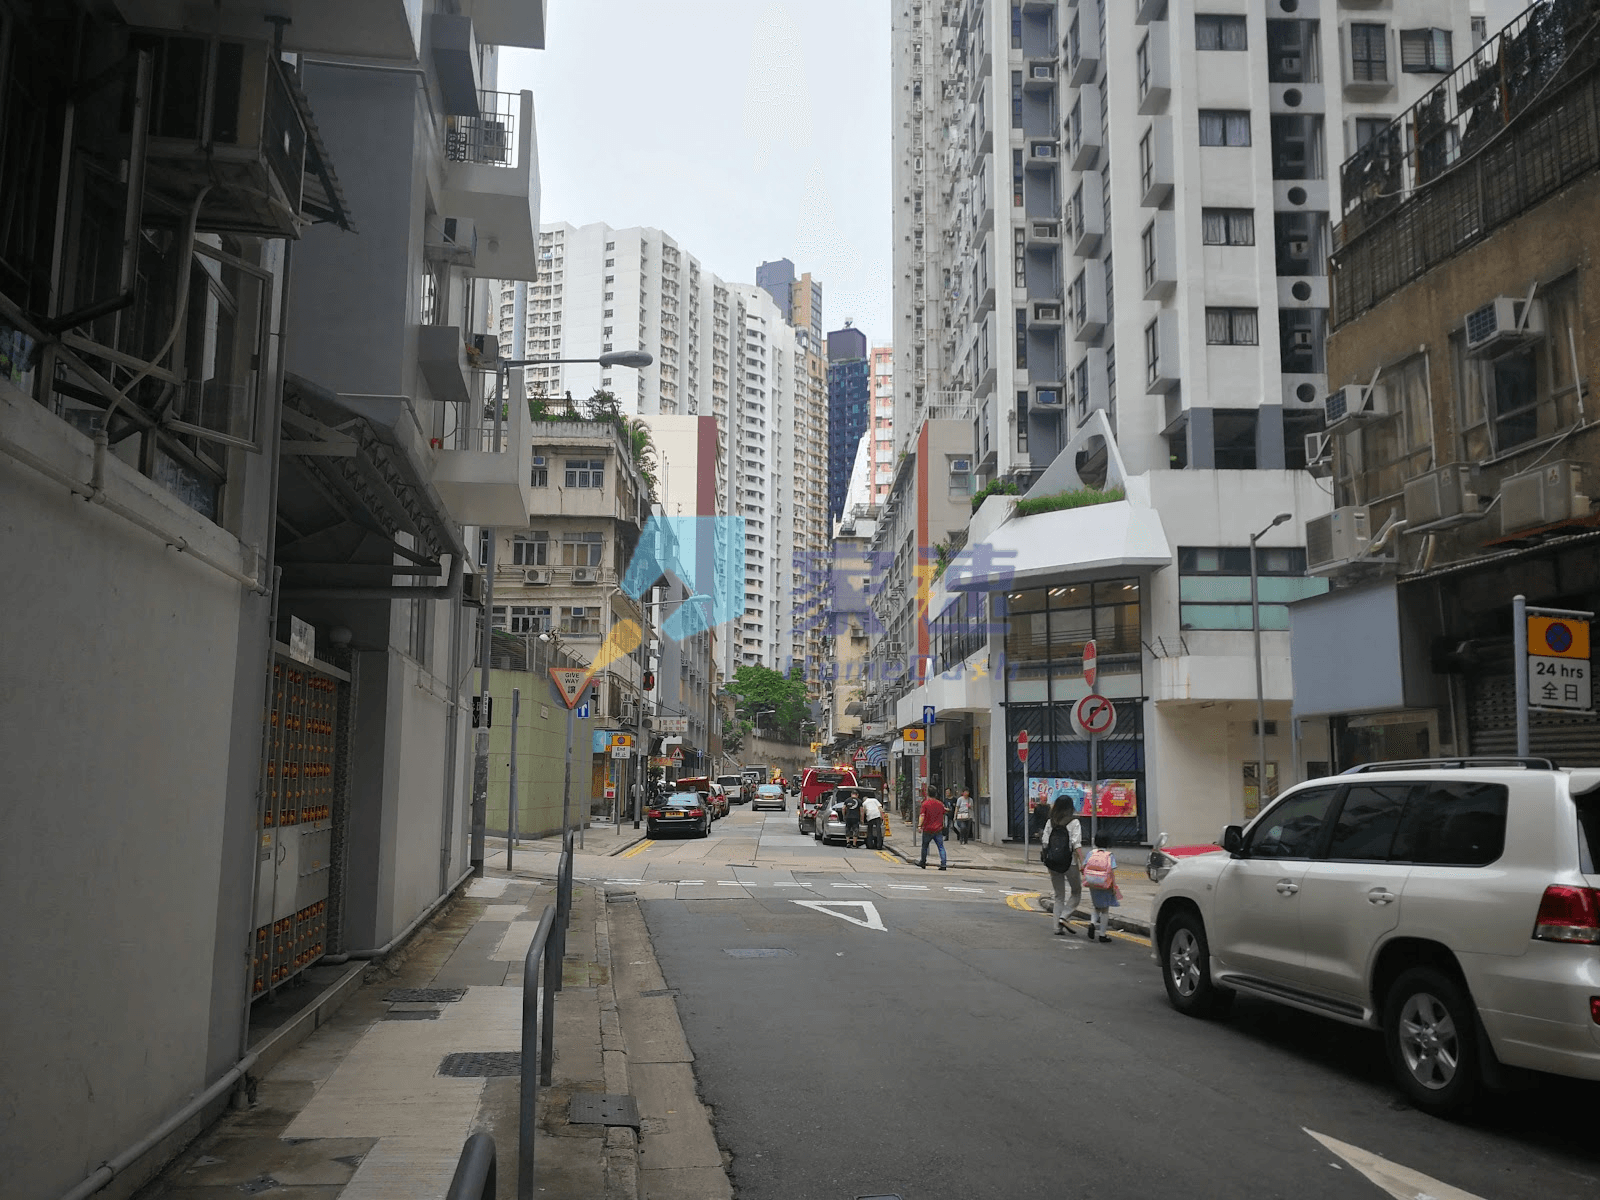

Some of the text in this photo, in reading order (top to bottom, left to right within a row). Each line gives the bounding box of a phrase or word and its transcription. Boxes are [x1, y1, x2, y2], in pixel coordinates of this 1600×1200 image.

[1536, 662, 1584, 679] 24 hrs
[1541, 681, 1578, 702] 全日
[1031, 781, 1054, 796] 2019
